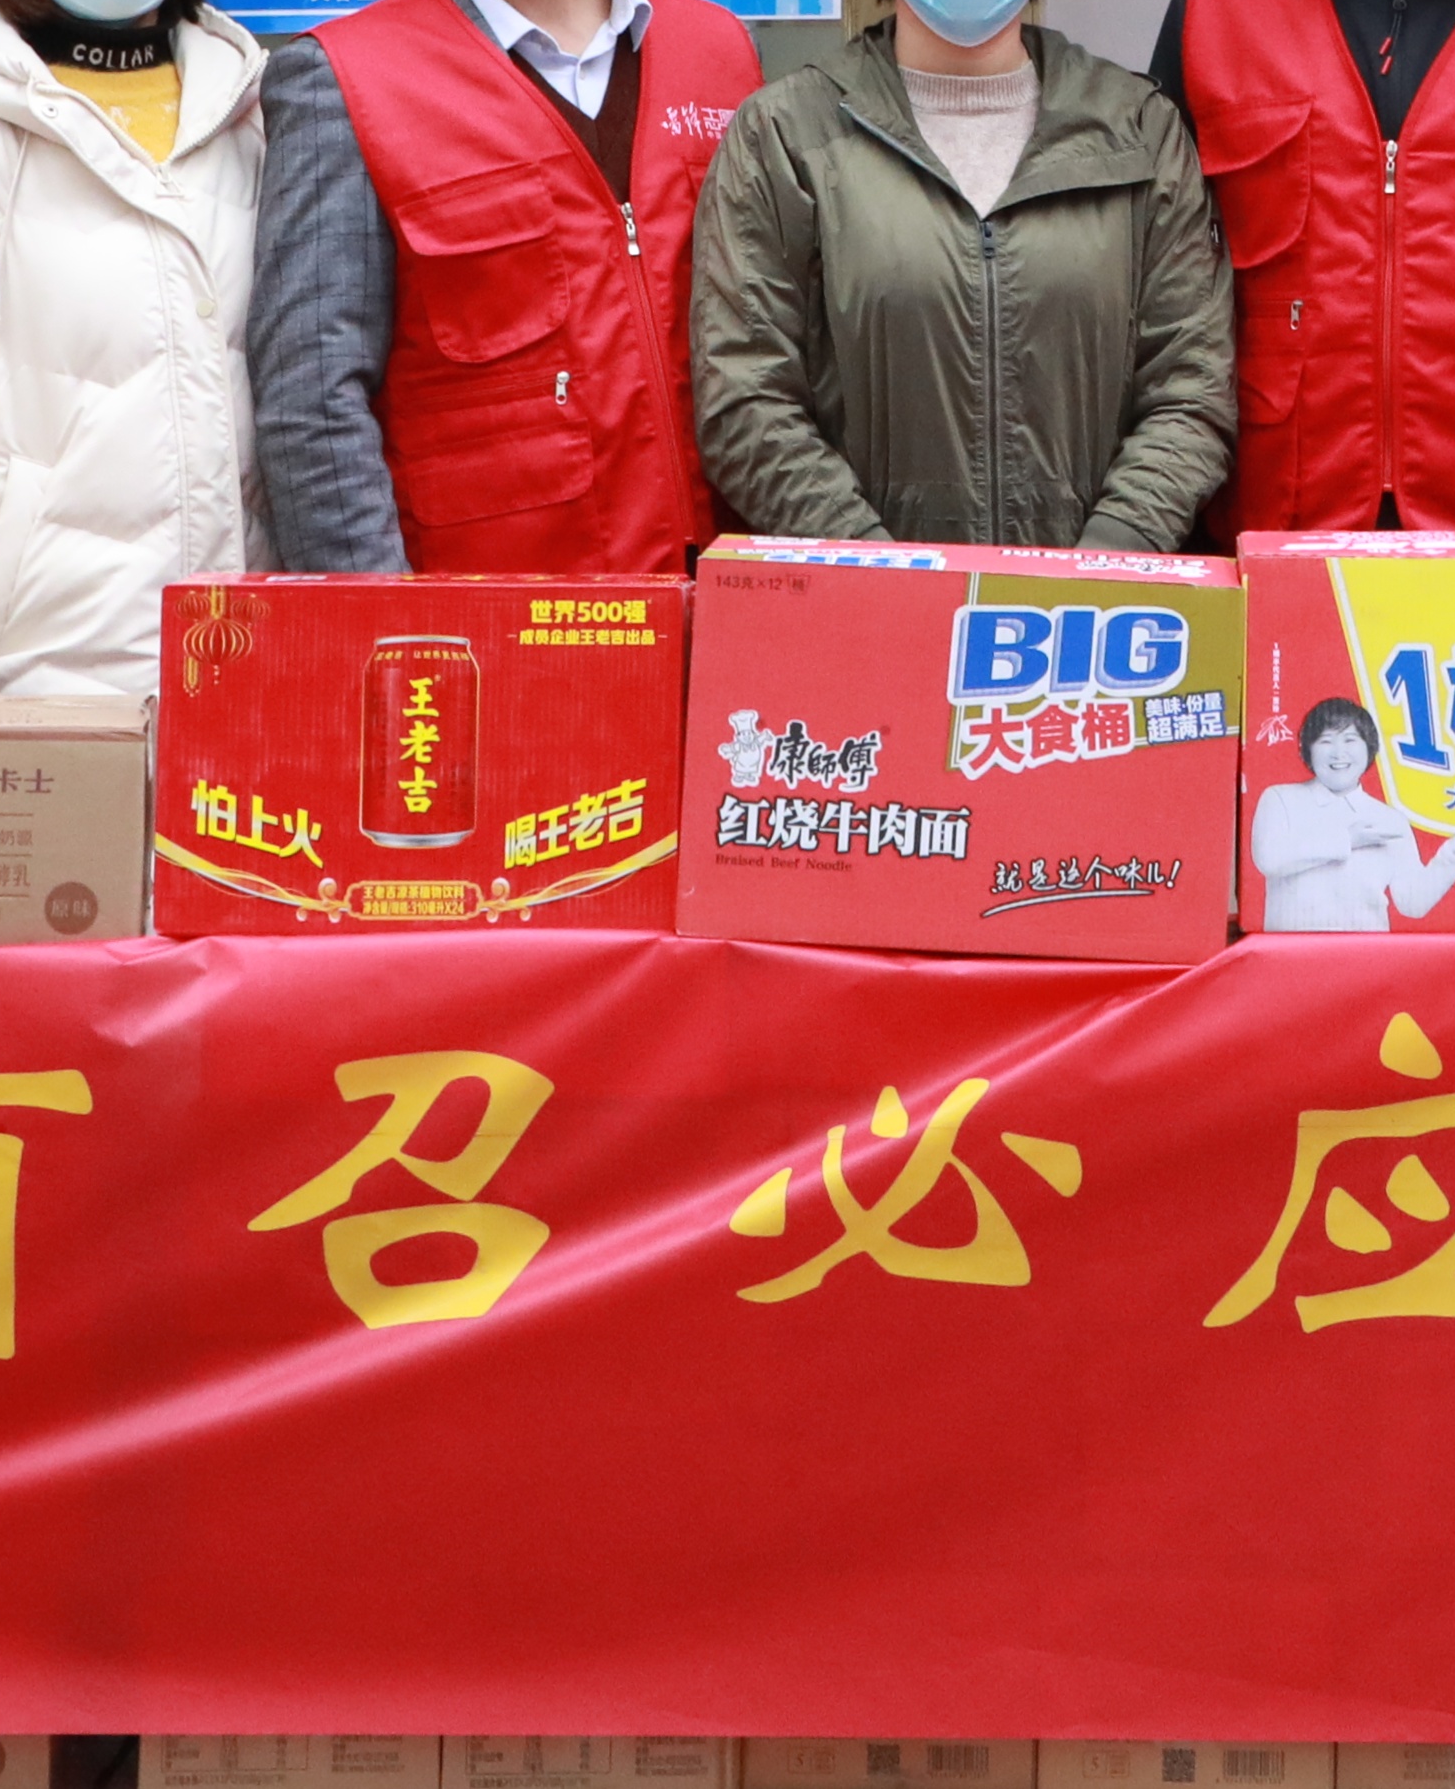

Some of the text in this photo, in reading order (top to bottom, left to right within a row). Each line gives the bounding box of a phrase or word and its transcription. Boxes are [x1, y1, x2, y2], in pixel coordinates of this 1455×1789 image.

[72, 44, 154, 69] COLLAR
[530, 599, 647, 623] 世界500强
[954, 610, 1185, 699] BIG
[398, 677, 440, 814] 王老吉
[965, 702, 1131, 771] 大食桶
[1146, 714, 1226, 744] 超满足
[190, 778, 324, 869] 怕上火
[504, 777, 647, 870] 喝王老吉
[716, 794, 971, 860] 红烧牛肉面
